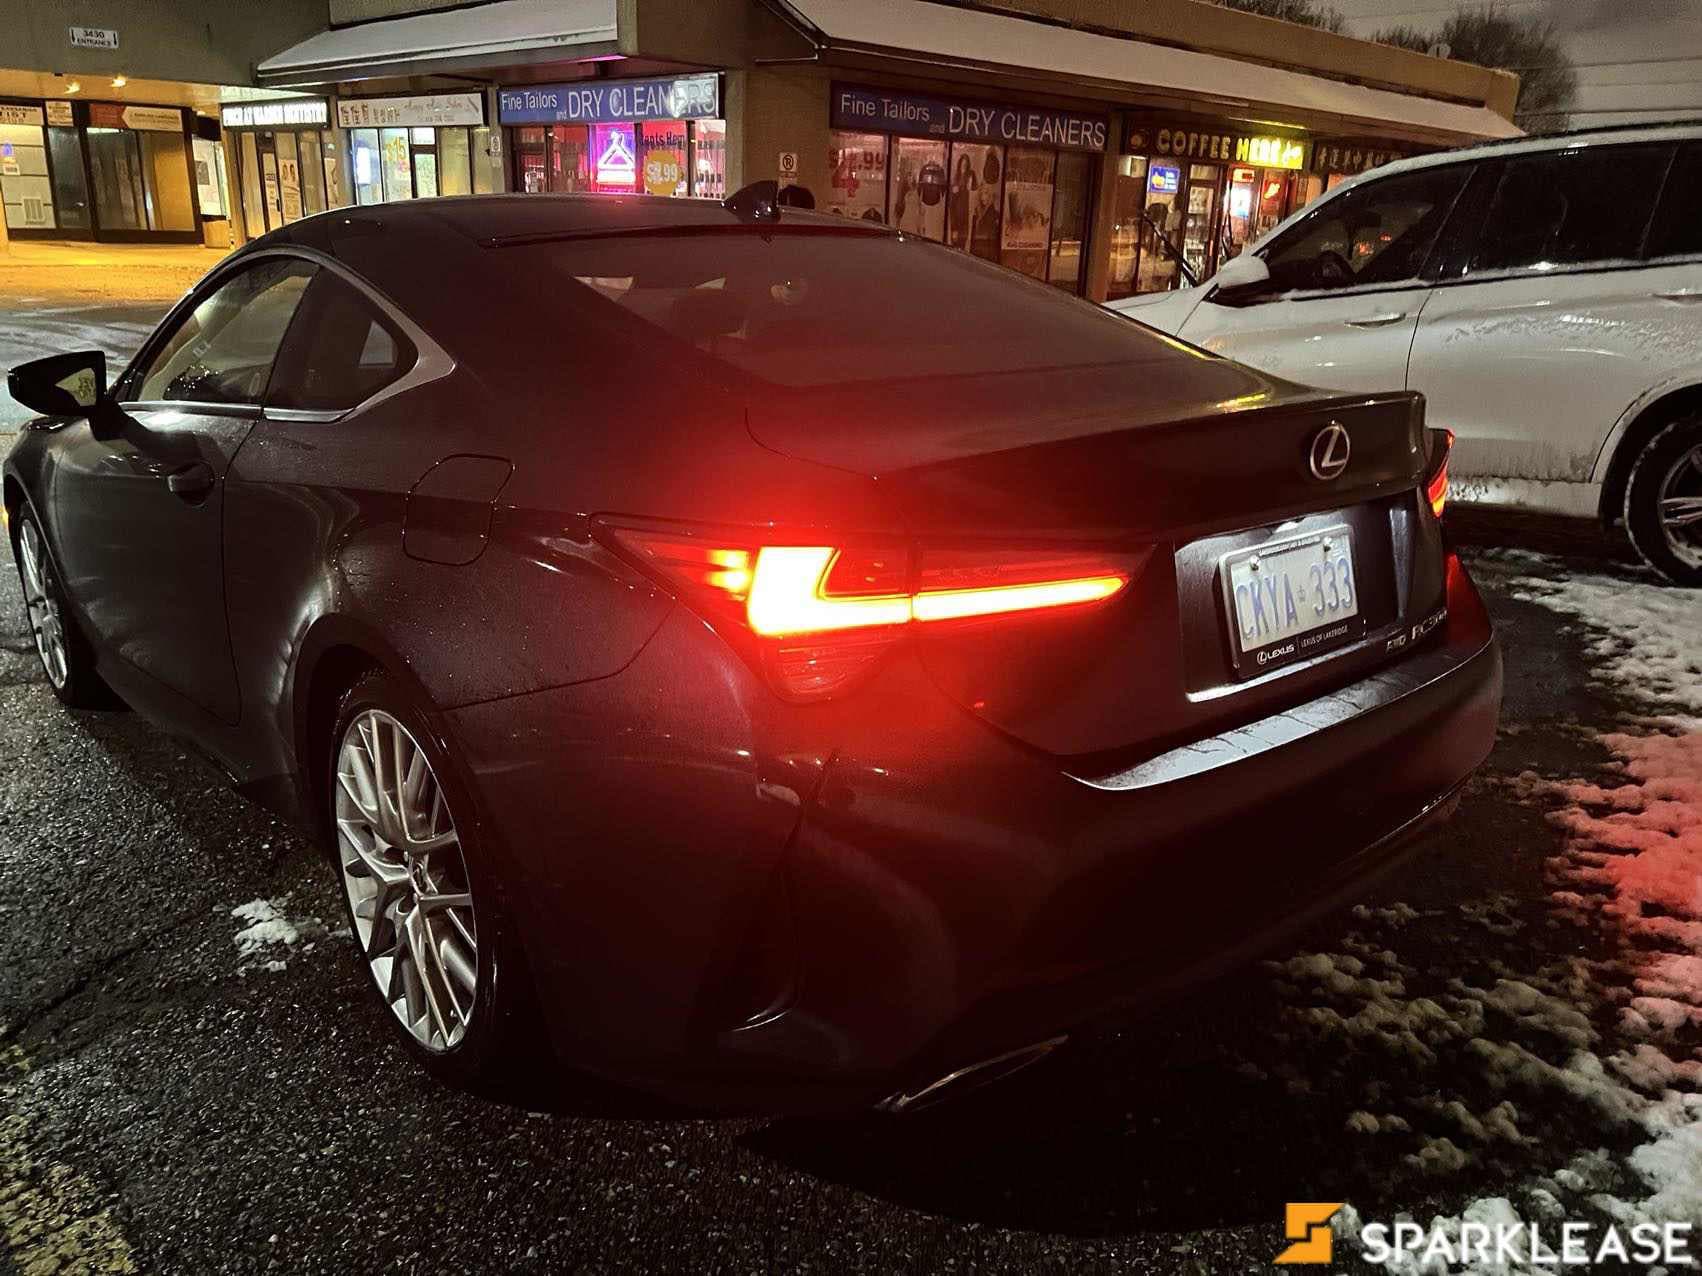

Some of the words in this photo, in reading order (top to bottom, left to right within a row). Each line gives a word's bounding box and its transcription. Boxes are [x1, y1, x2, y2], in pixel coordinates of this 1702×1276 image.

[501, 93, 522, 111] Fine
[523, 91, 558, 110] Tailors
[568, 89, 604, 118] DRY
[841, 94, 876, 117] Fine
[881, 98, 930, 122] Tailors
[949, 105, 996, 135] DRY
[1000, 112, 1105, 148] CLEANERS
[1157, 128, 1231, 161] COFFEE
[1235, 573, 1299, 642] CKYA
[1309, 557, 1353, 617] 333
[1267, 643, 1295, 660] LEXUS
